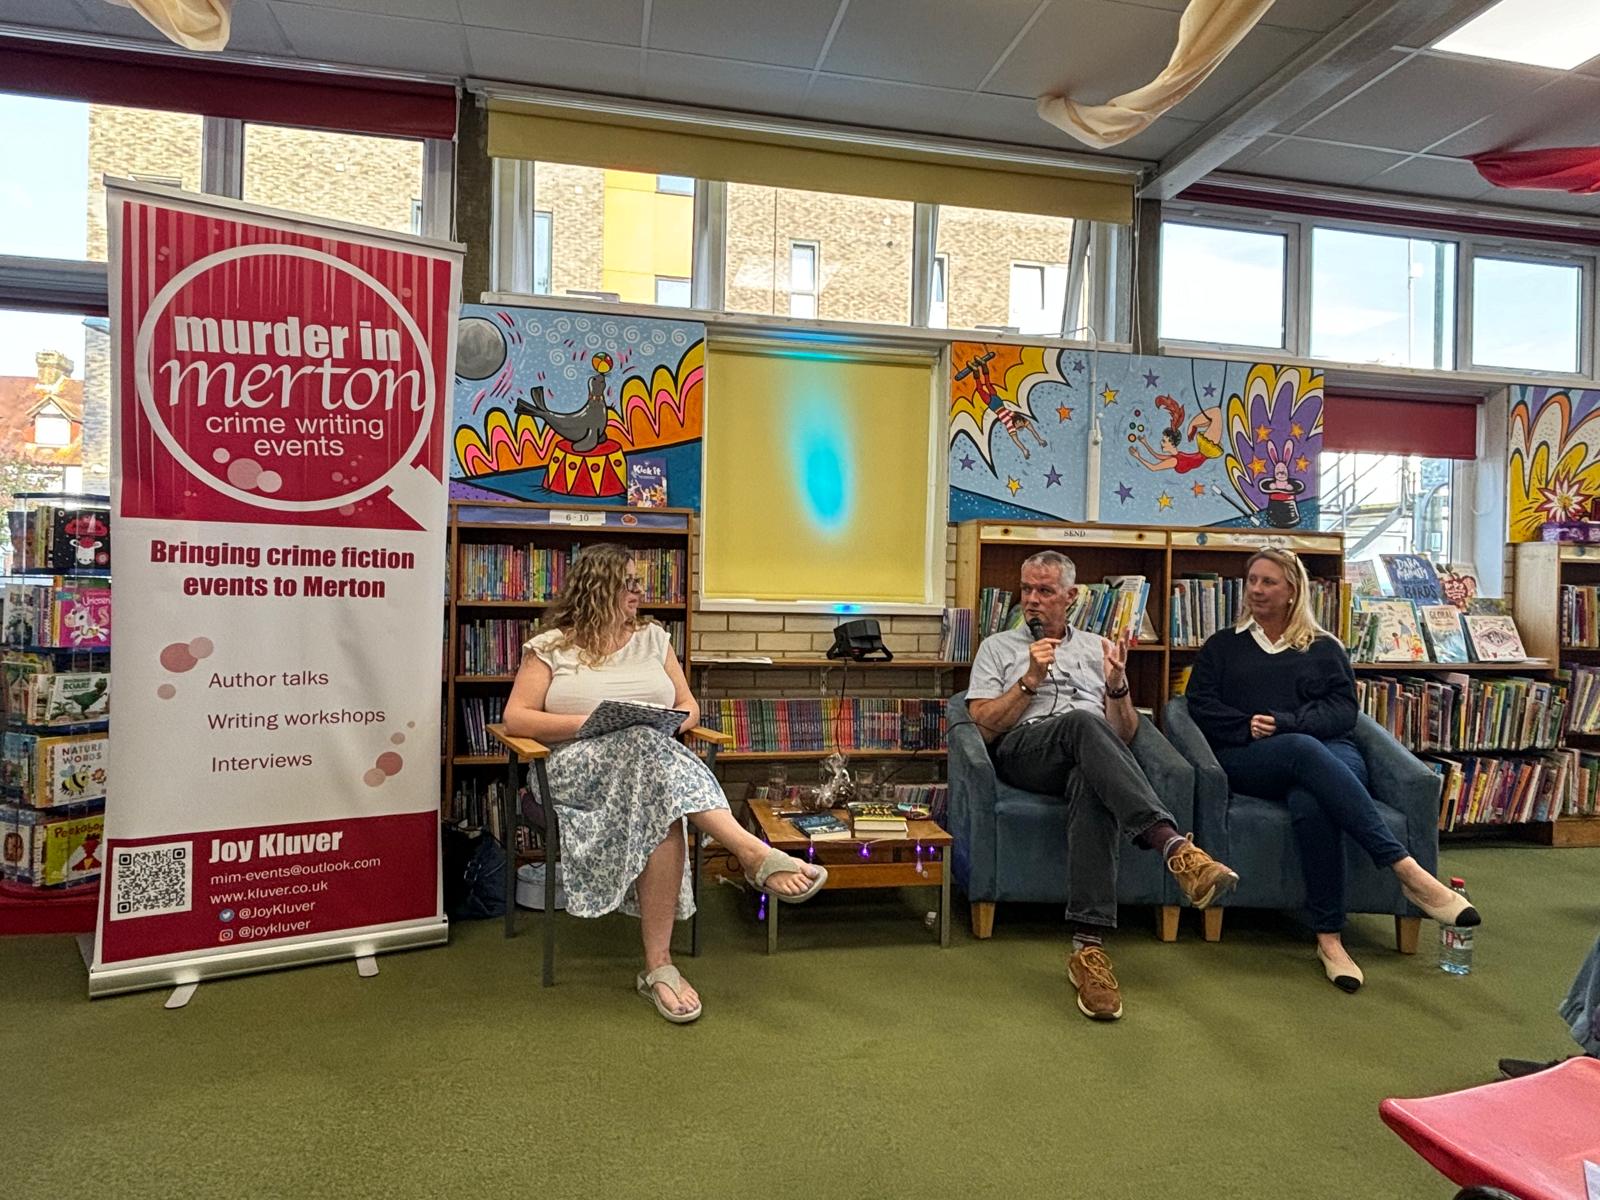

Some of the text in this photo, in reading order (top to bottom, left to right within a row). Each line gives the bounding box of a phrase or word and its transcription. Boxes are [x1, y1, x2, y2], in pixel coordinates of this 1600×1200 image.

[174, 315, 401, 362] murder in
[159, 356, 427, 412] merton
[205, 412, 384, 440] crime writing
[254, 436, 344, 457] events
[633, 464, 661, 475] Kick it
[566, 514, 572, 522] 6
[579, 514, 589, 522] 10
[1063, 530, 1086, 538] SEND
[150, 540, 415, 570] Bringing crime fiction
[183, 575, 386, 599] events to Merton
[1403, 584, 1438, 599] BIRDS
[208, 670, 329, 689] Author talks
[207, 708, 386, 731] Writing workshops
[211, 753, 313, 773] Interviews
[208, 829, 344, 864] Joy Kluver
[210, 856, 381, 886] mim-events@outlook.com
[209, 880, 329, 905] www.kluver.co.uk
[238, 899, 316, 921] @JoyKluver
[238, 918, 311, 940] @joykluver
